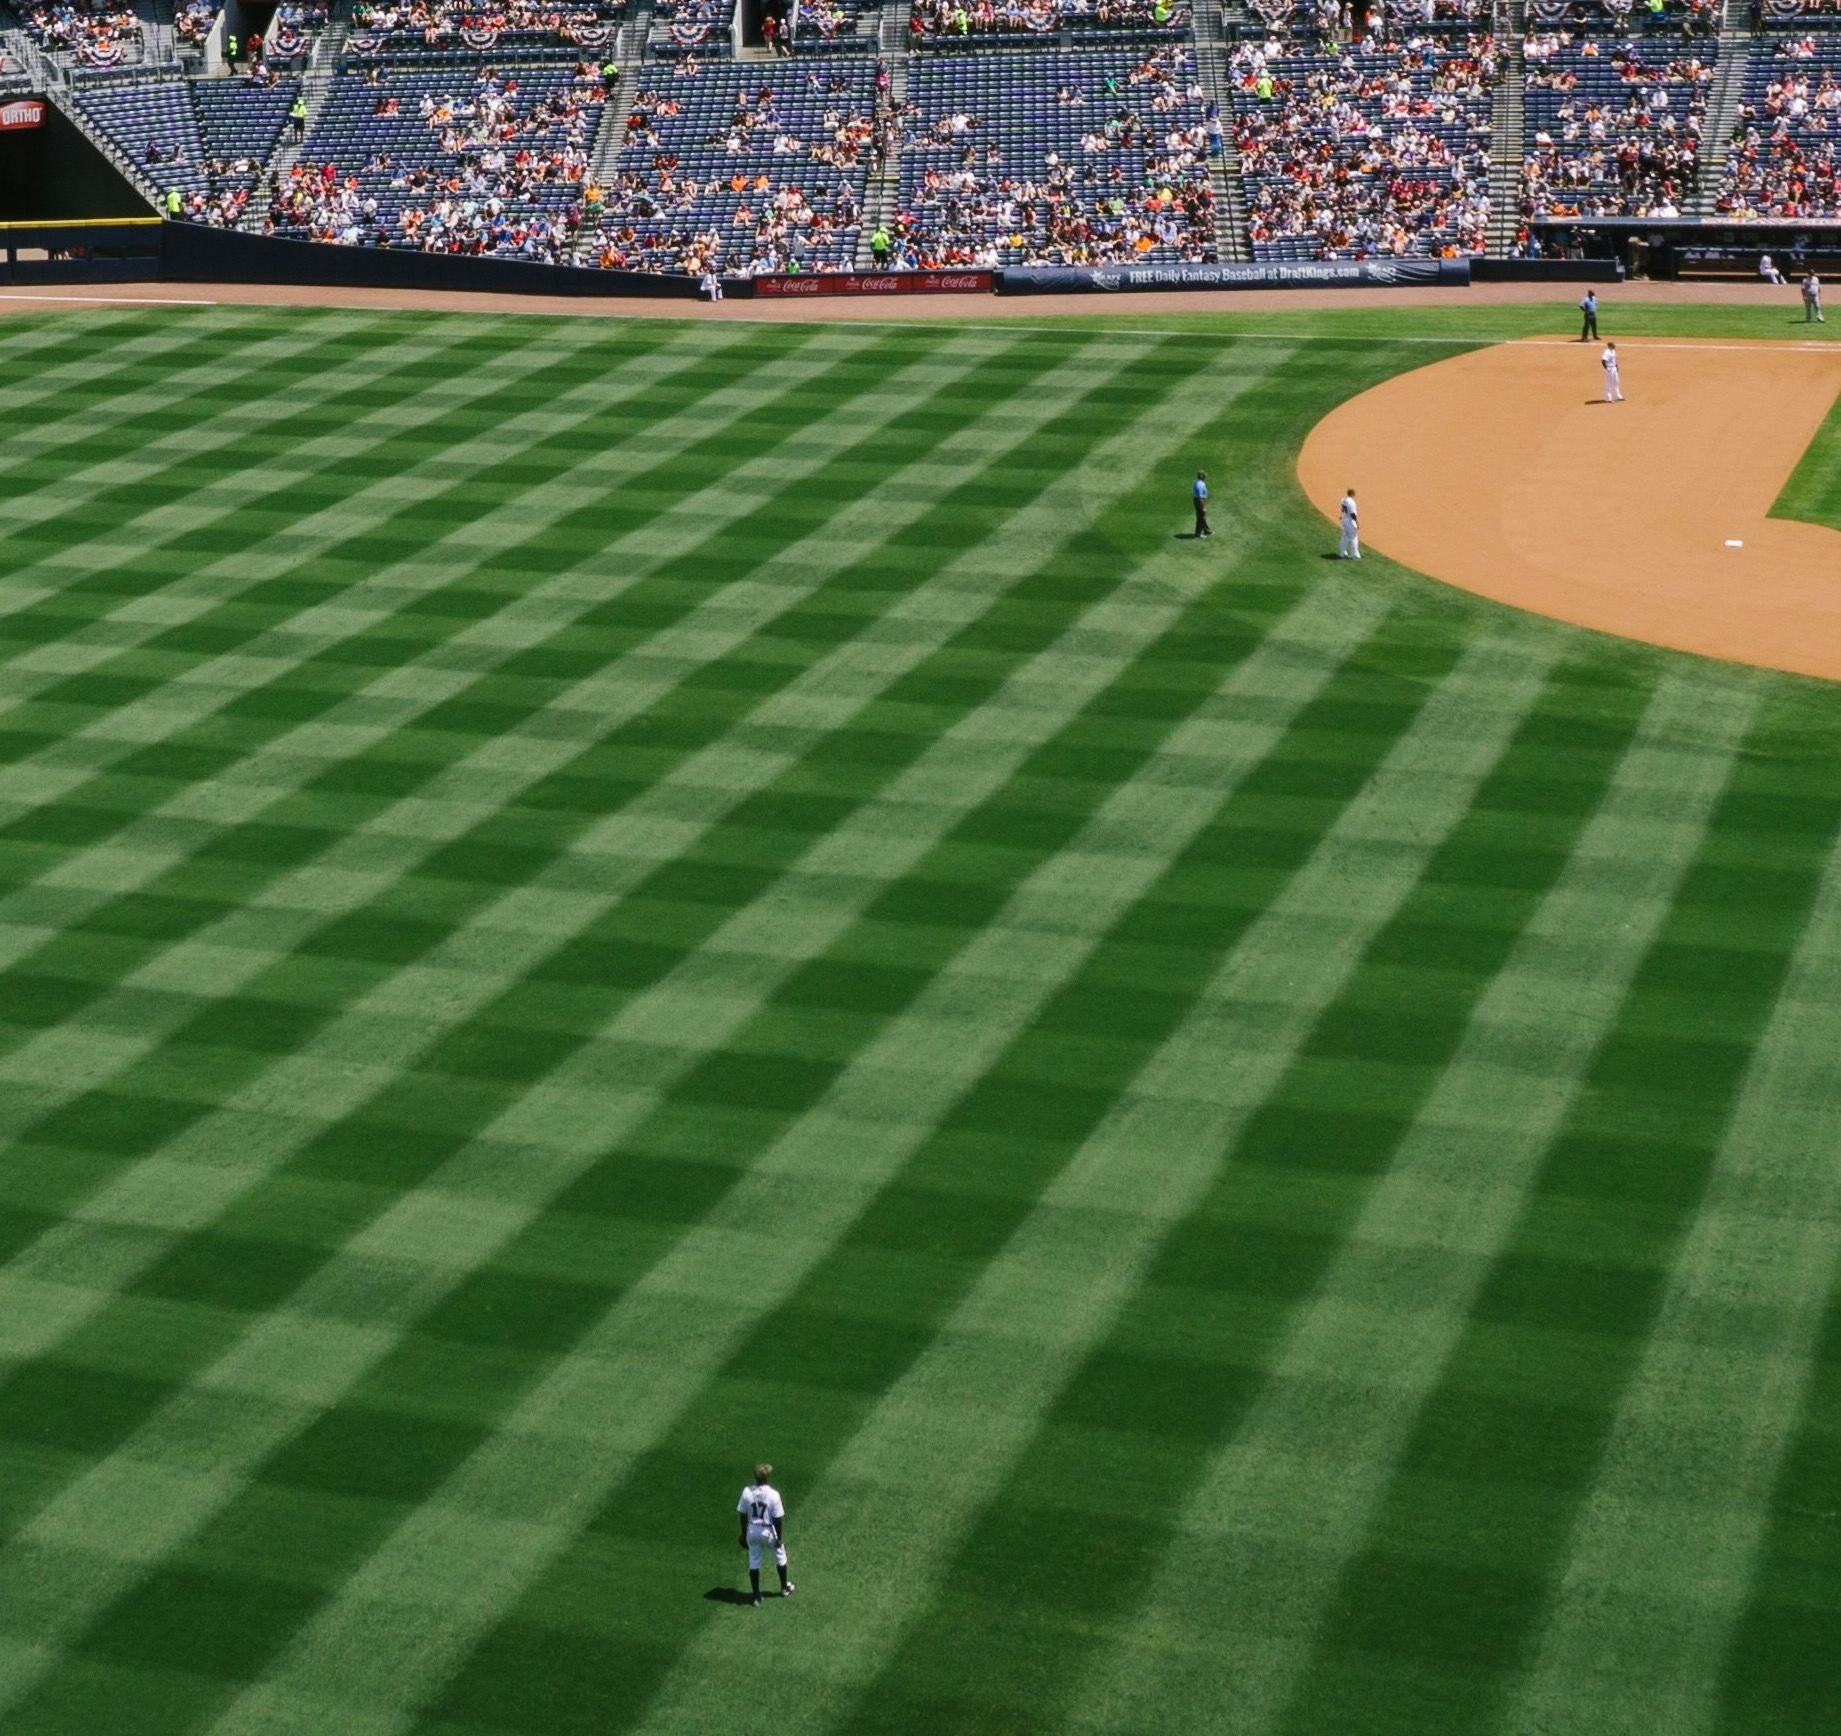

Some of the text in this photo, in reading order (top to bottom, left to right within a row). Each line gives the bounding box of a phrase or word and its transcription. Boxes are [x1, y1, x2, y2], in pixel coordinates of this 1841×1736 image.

[2, 107, 41, 126] ORTHO
[1129, 270, 1154, 284] FREE
[1155, 269, 1181, 284] Daily
[1181, 268, 1221, 284] Fantasy
[1222, 268, 1266, 281] Baseball
[1267, 267, 1279, 280] at
[1279, 266, 1359, 280] DraftKings.com
[751, 1501, 767, 1519] 17
